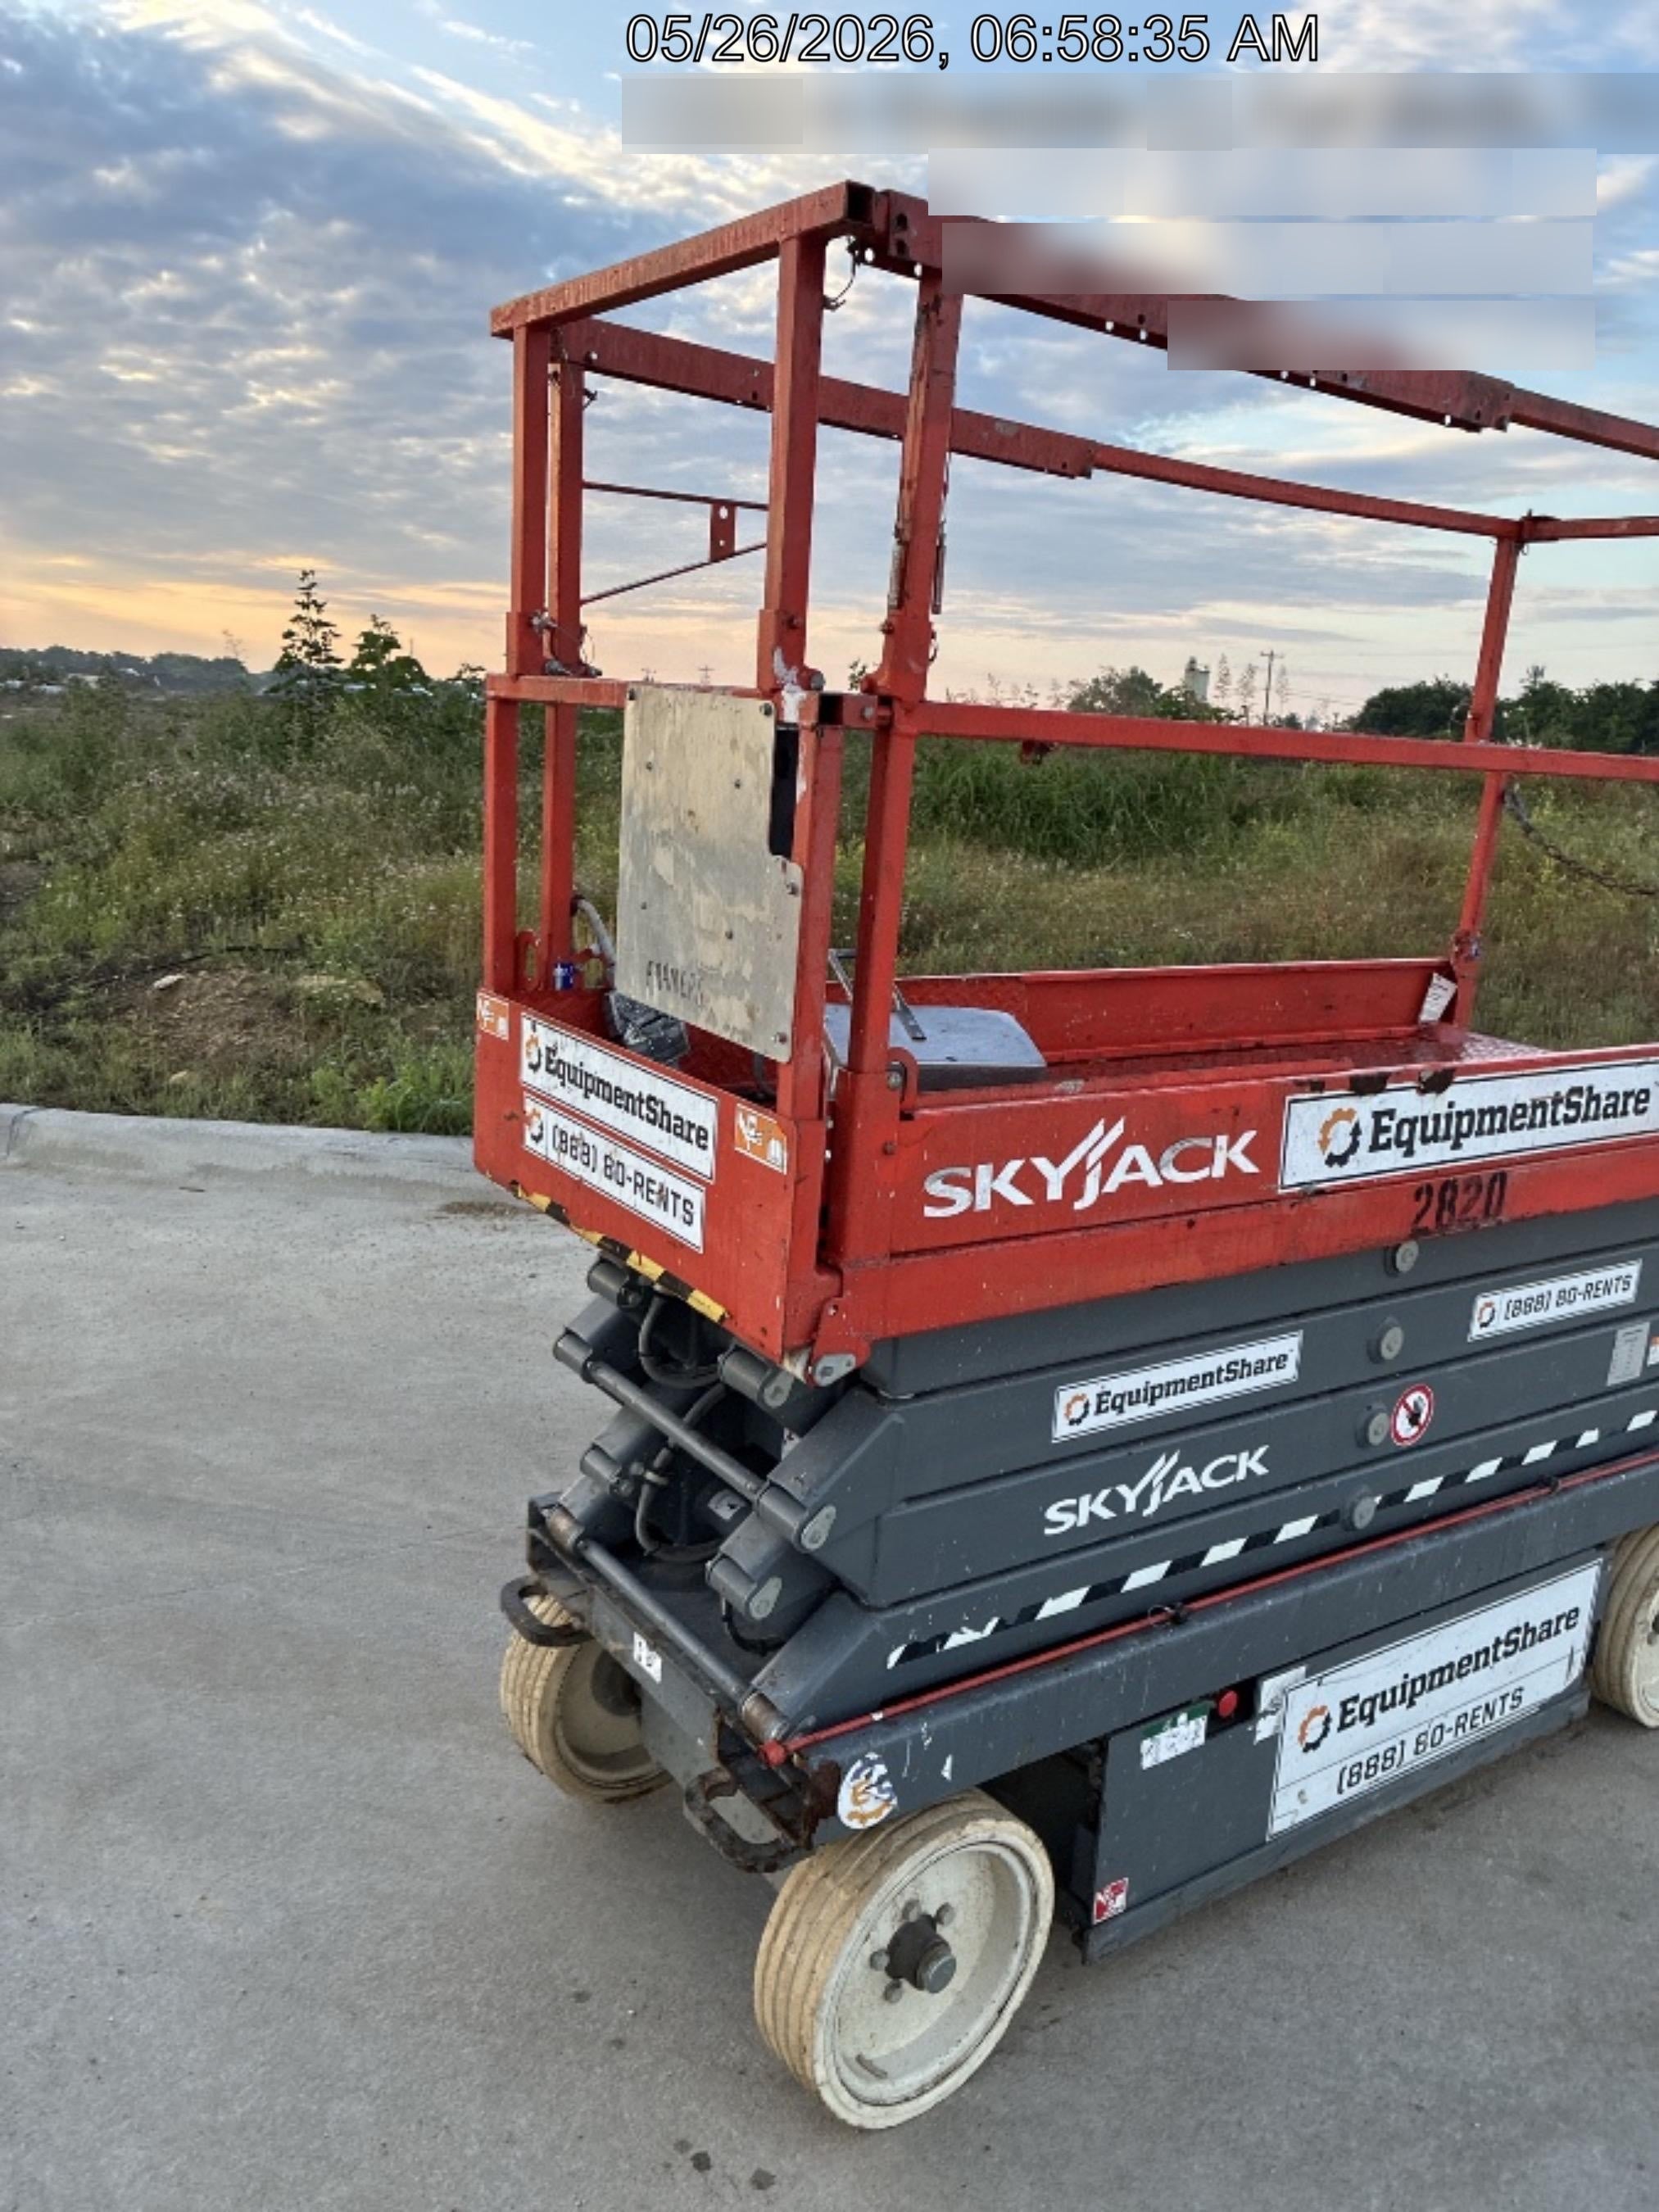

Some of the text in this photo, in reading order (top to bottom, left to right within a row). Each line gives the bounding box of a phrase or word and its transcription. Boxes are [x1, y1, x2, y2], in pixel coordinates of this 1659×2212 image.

[544, 1046, 709, 1150] EquipmentShare
[1368, 1085, 1651, 1158] EquipmentShare
[551, 1123, 694, 1226] (888) 80-RENTS
[923, 1115, 1260, 1218] SKYJACK
[1410, 1171, 1507, 1235] 2820
[1503, 1274, 1633, 1321] (888) 80-RENTS
[1094, 1352, 1289, 1416] EquipmentShare
[1044, 1444, 1270, 1536] SKYJACK
[1336, 1606, 1580, 1734] EquipmentShare
[1335, 1686, 1525, 1795] (888) 80-RENTS
